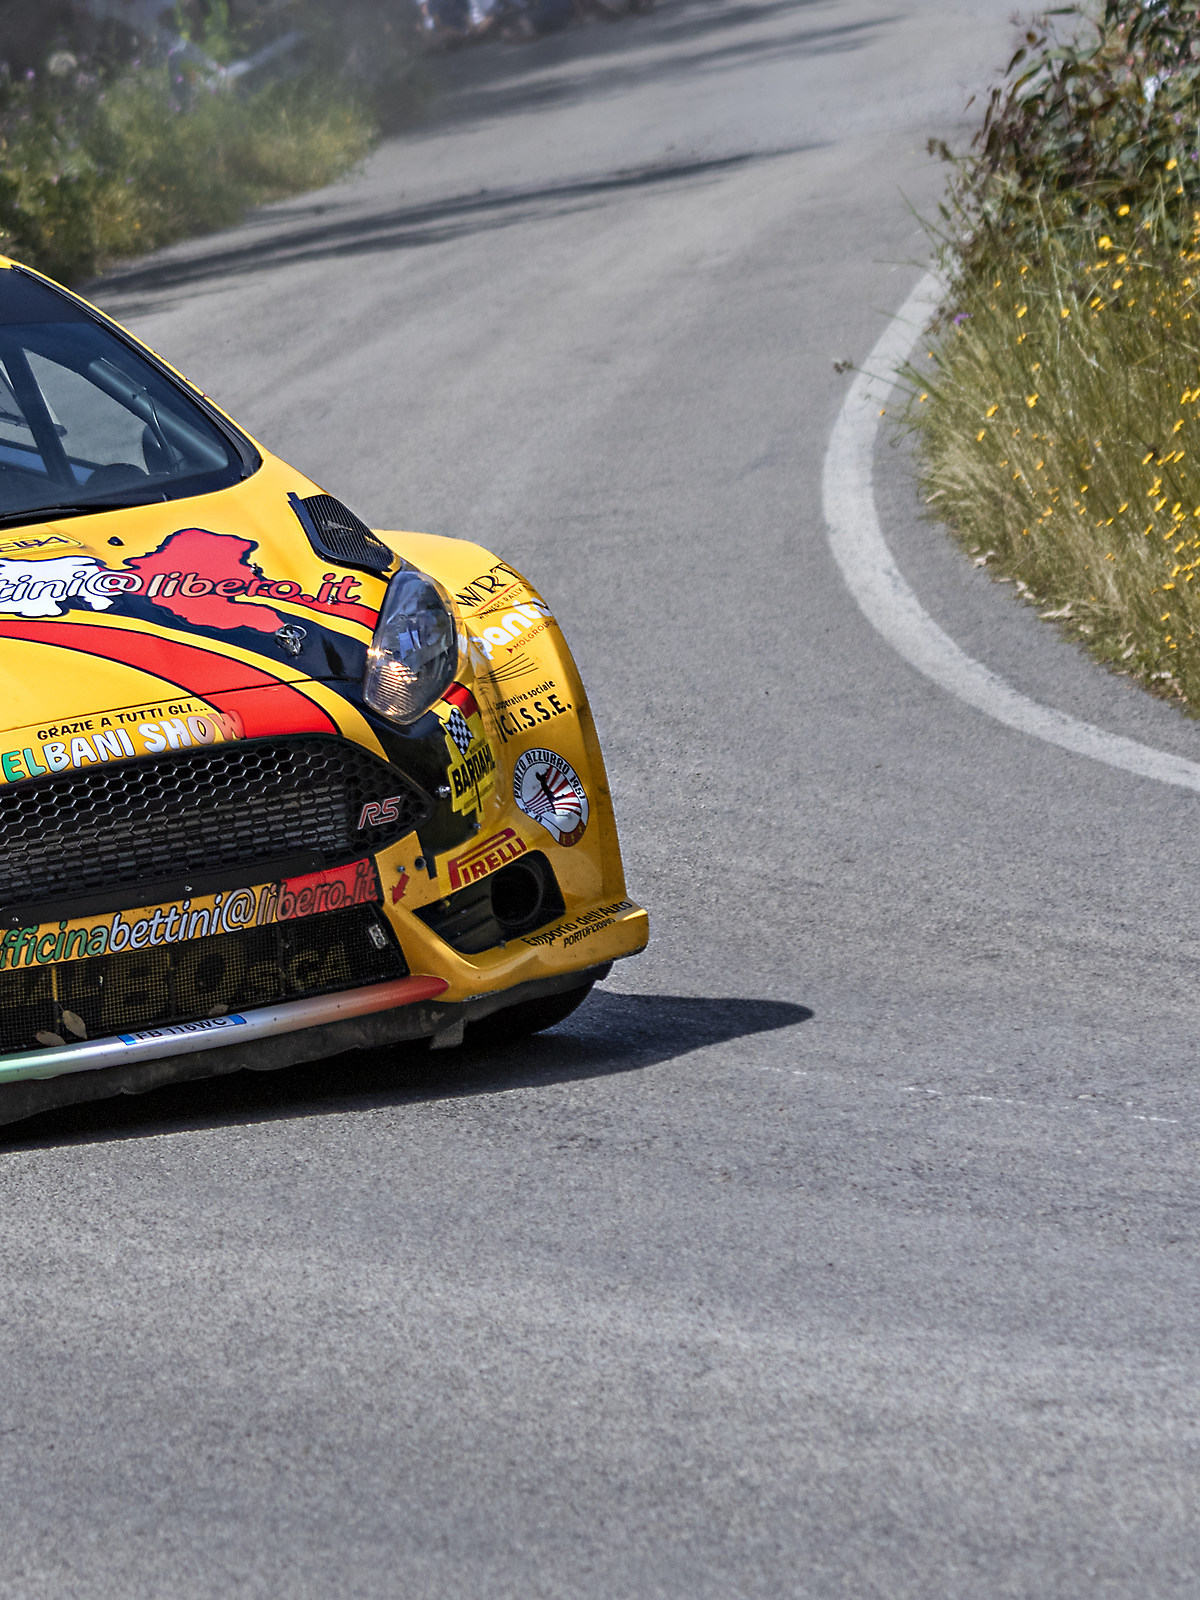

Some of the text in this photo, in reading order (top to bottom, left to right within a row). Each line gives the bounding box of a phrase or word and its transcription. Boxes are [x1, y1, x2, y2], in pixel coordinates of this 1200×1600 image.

[456, 562, 522, 608] WRT
[527, 679, 556, 701] sociale
[36, 720, 94, 741] GRAZIE
[100, 717, 113, 728] A
[114, 707, 165, 724] TUTTI
[1, 710, 246, 783] ELBANI SHOW
[526, 750, 570, 776] AZZURRO
[447, 827, 528, 891] PIRELLI
[520, 900, 633, 947] Emporio dell'Auto
[563, 918, 617, 948] PORTOFERRAIO
[136, 1017, 228, 1040] FB 116WC
